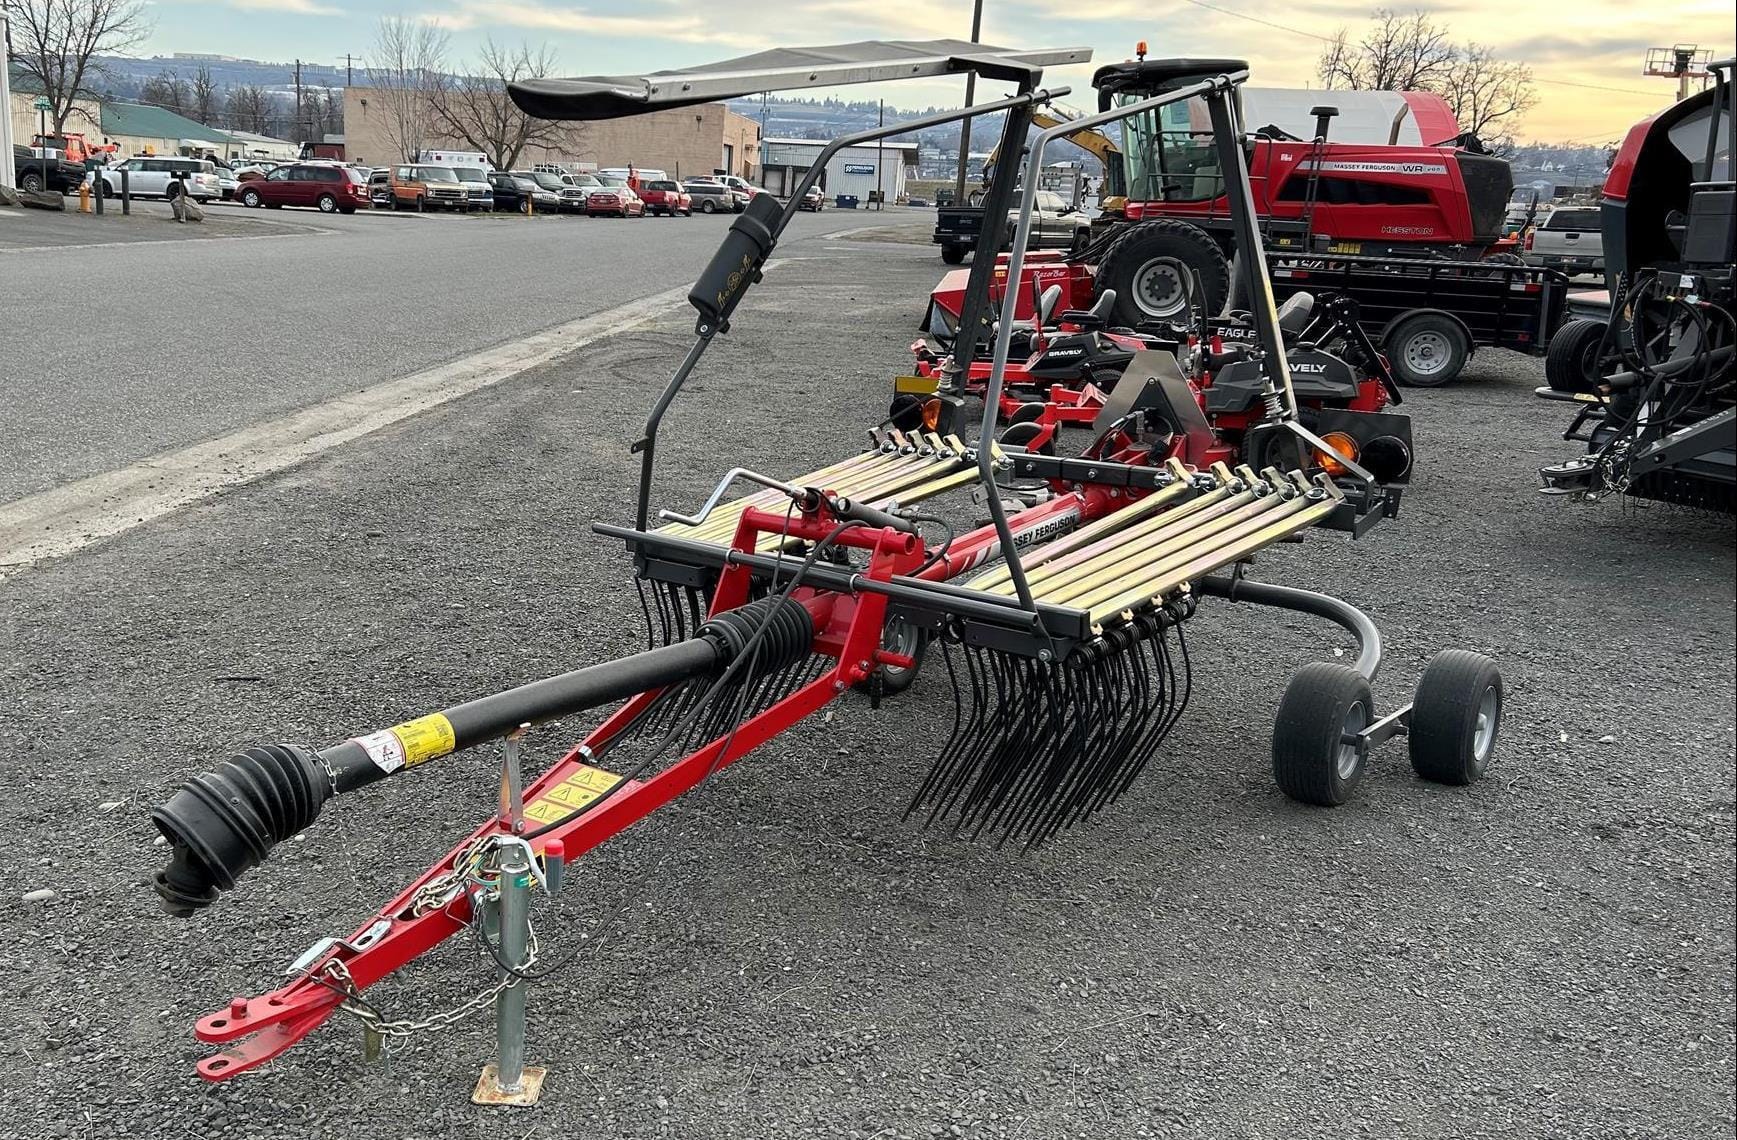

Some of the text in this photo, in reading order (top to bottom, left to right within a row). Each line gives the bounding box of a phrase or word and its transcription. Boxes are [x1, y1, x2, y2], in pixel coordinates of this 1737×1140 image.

[1217, 327, 1257, 338] EAGLE
[1013, 514, 1076, 547] SSEY FERGUSON
